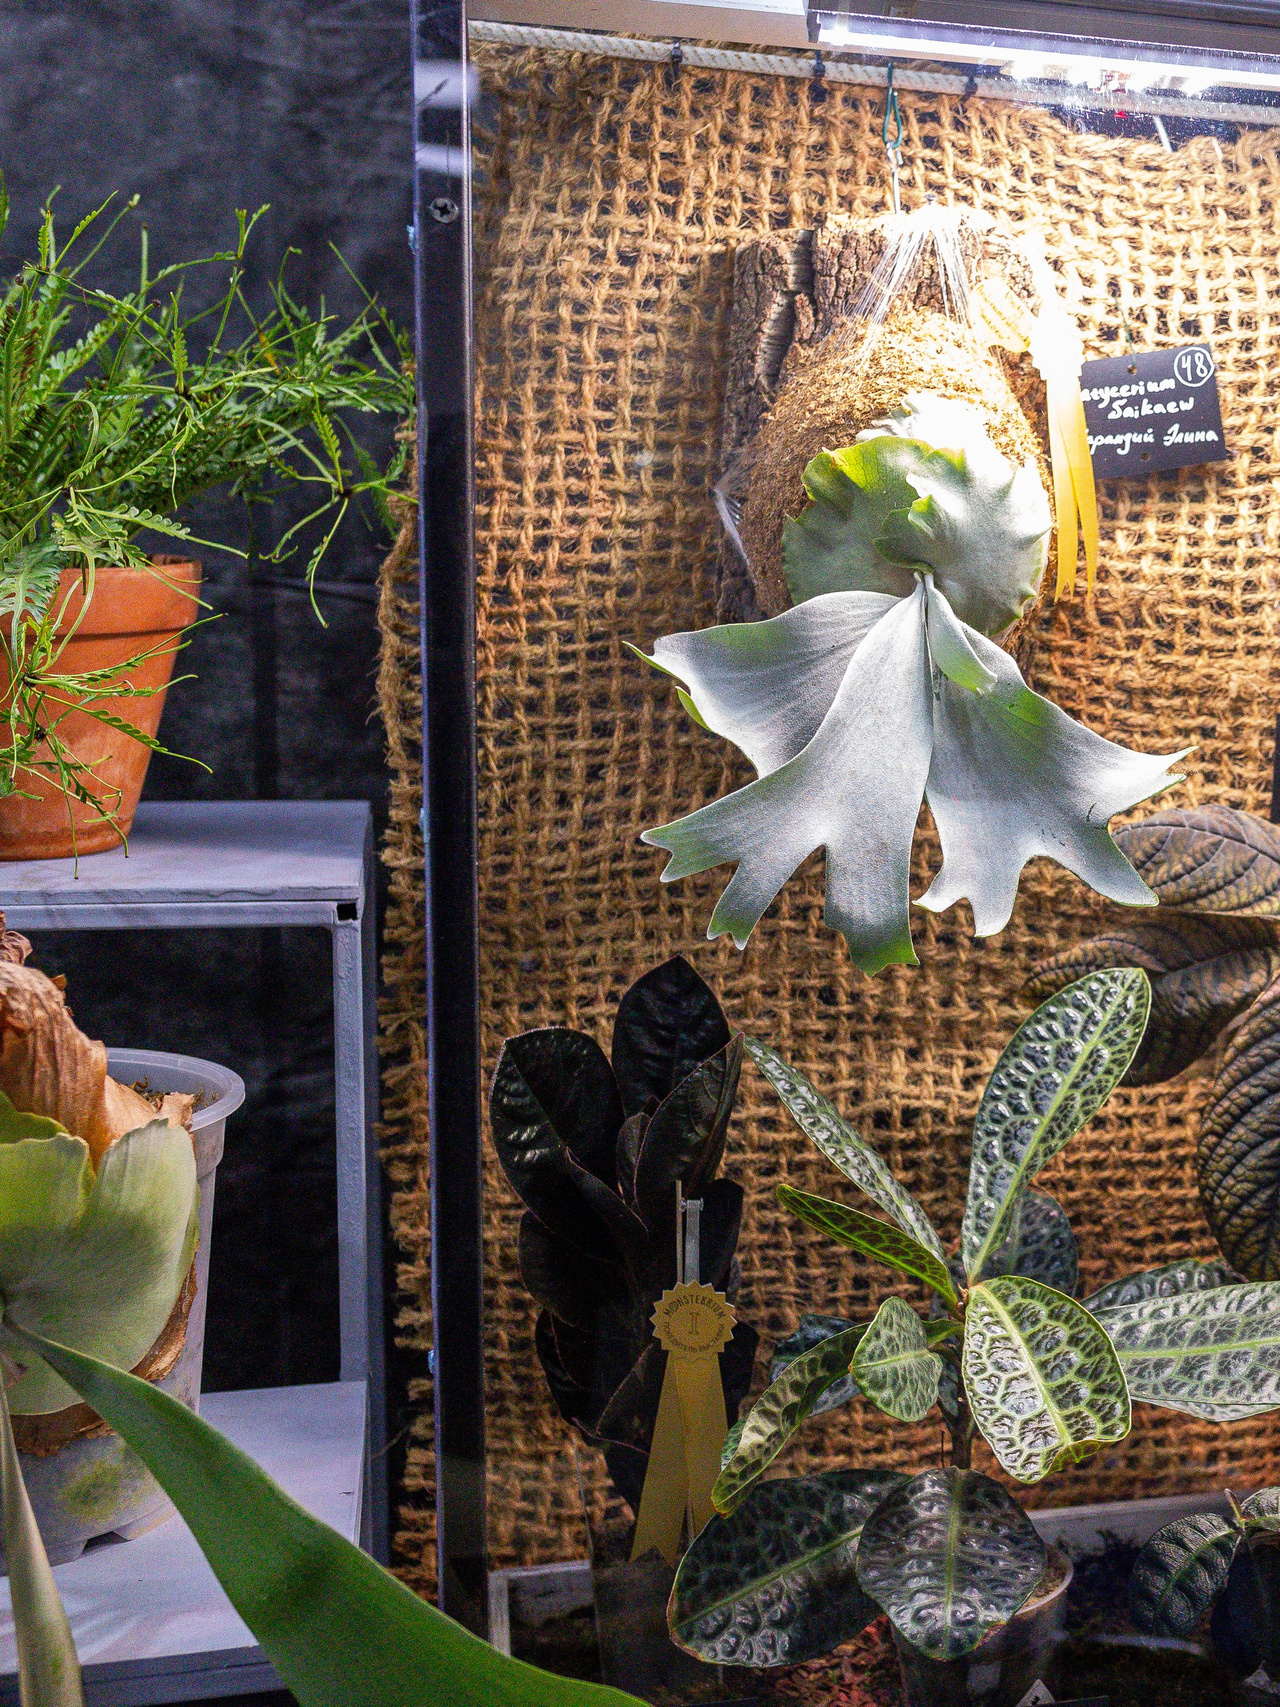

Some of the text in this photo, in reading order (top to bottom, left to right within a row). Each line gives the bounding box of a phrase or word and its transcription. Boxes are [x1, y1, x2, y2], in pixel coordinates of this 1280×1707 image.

[1180, 351, 1208, 382] 48
[1080, 378, 1176, 408] atycerium
[1107, 396, 1195, 420] Saikaew
